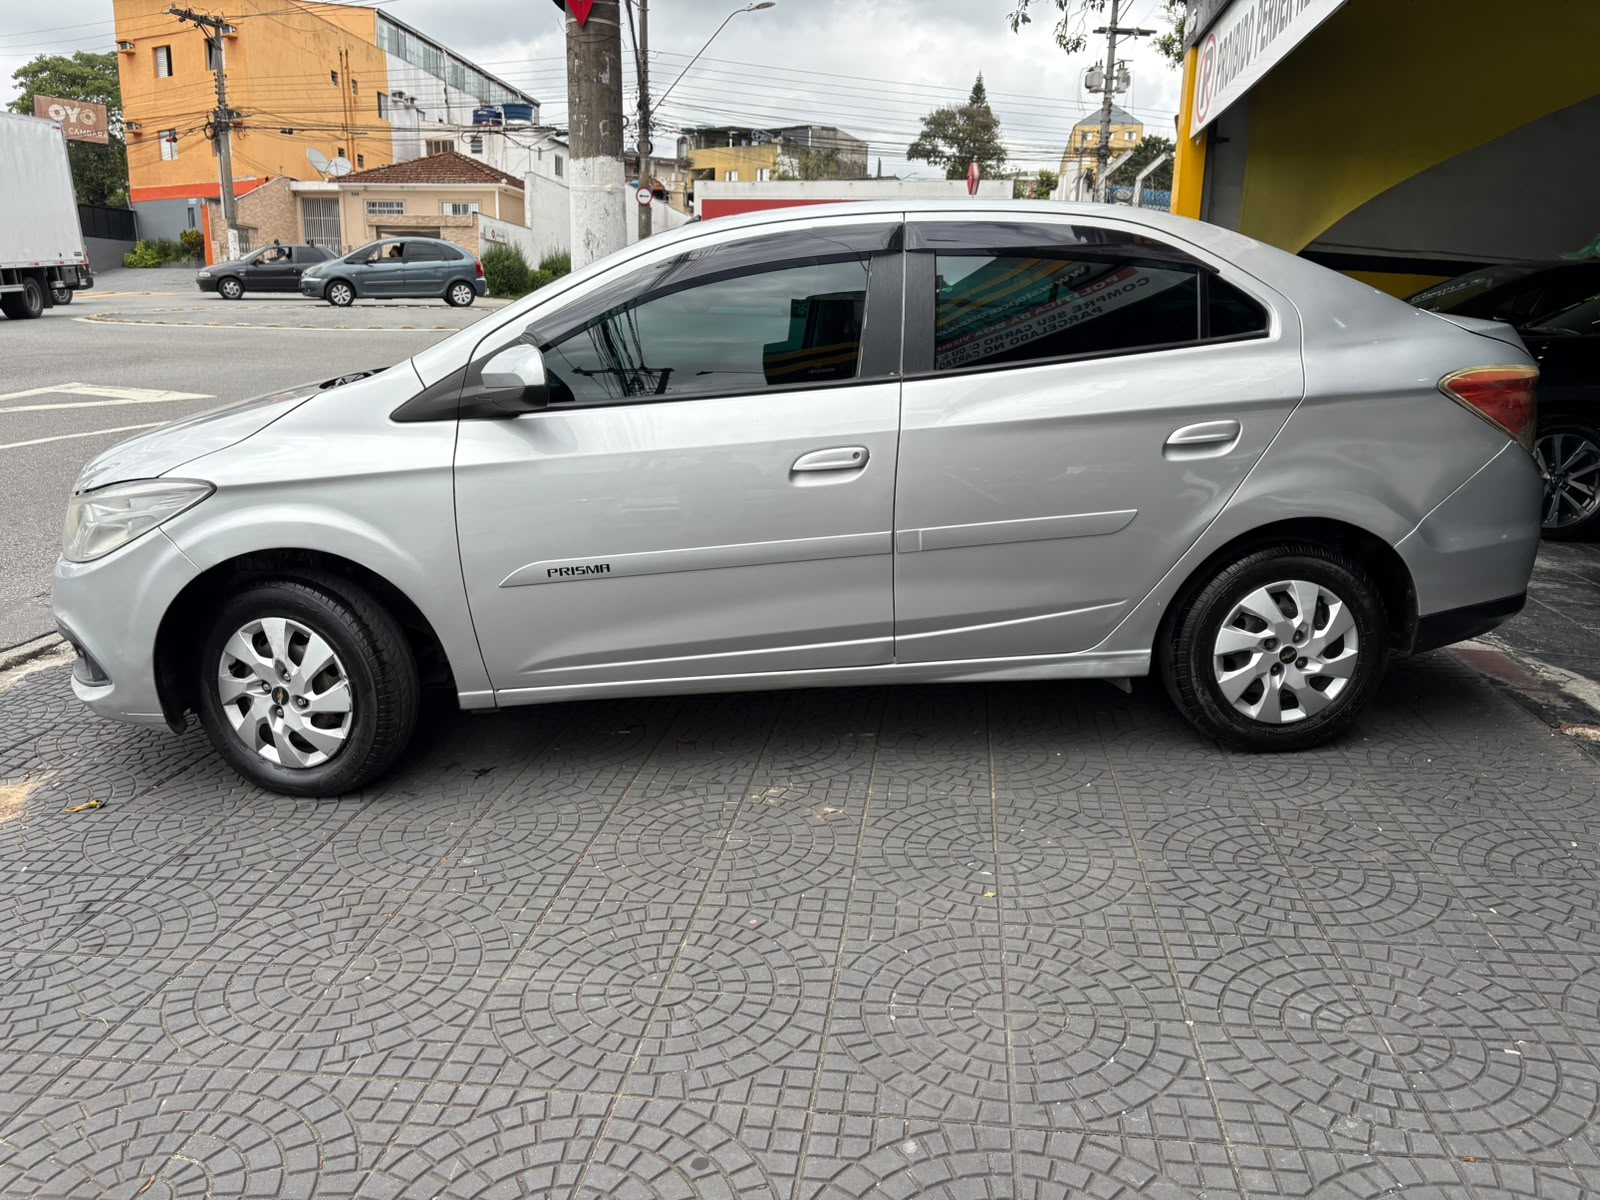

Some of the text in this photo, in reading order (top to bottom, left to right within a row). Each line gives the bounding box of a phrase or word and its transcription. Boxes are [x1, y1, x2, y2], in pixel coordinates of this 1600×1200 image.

[1215, 5, 1255, 96] PROIBIDO
[48, 103, 97, 126] OYO
[547, 563, 611, 578] PRISMA
